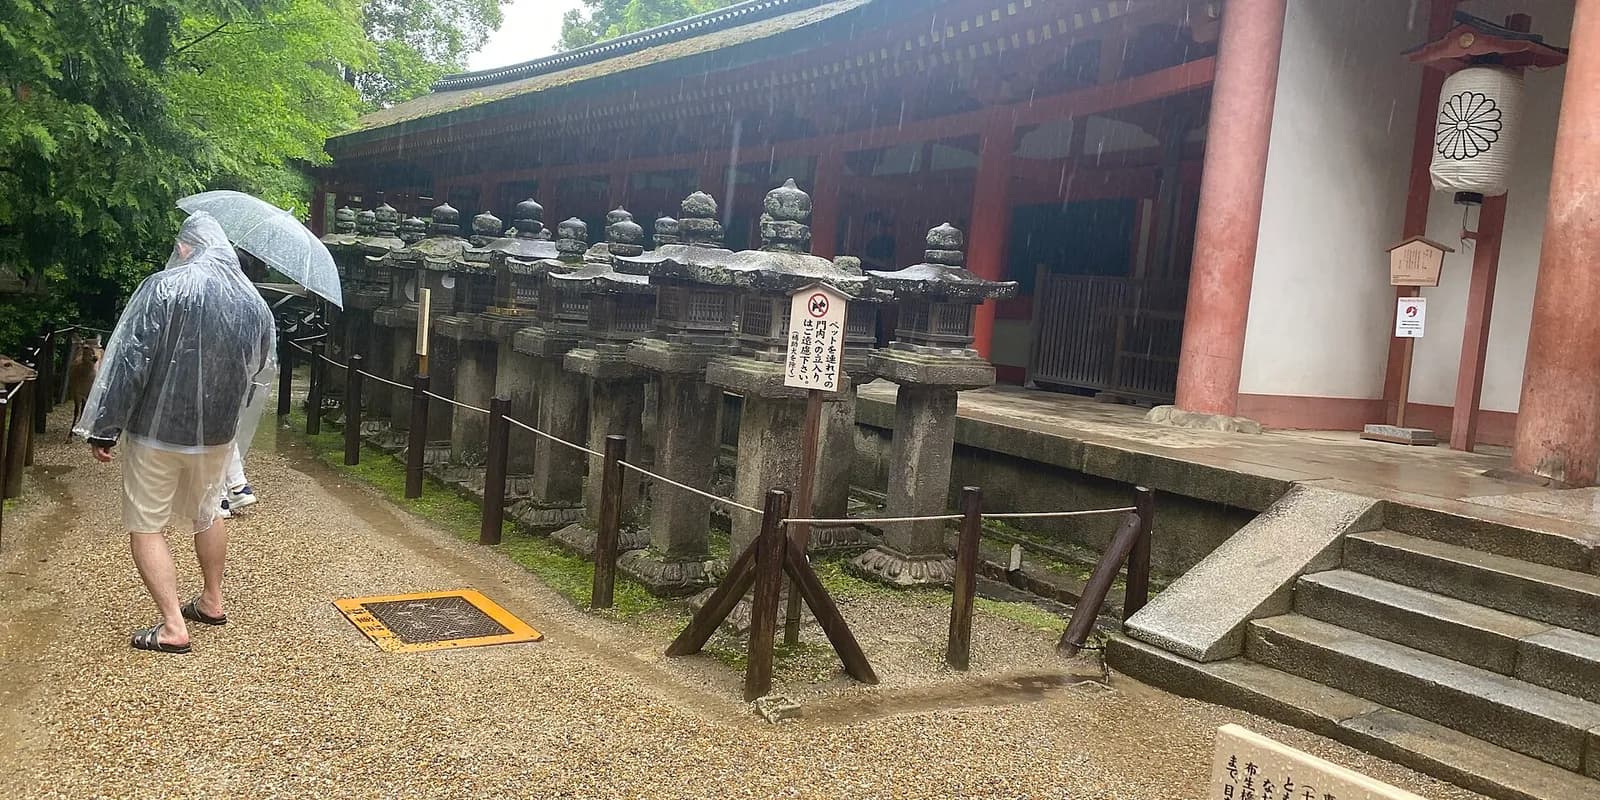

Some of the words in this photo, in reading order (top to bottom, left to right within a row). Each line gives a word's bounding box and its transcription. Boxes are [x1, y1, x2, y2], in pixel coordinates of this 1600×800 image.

[799, 319, 813, 385] はご遠慮下さい。
[812, 320, 827, 383] 門内への立入り
[824, 321, 840, 389] ペットを連れての
[1224, 754, 1238, 800] まで、目
